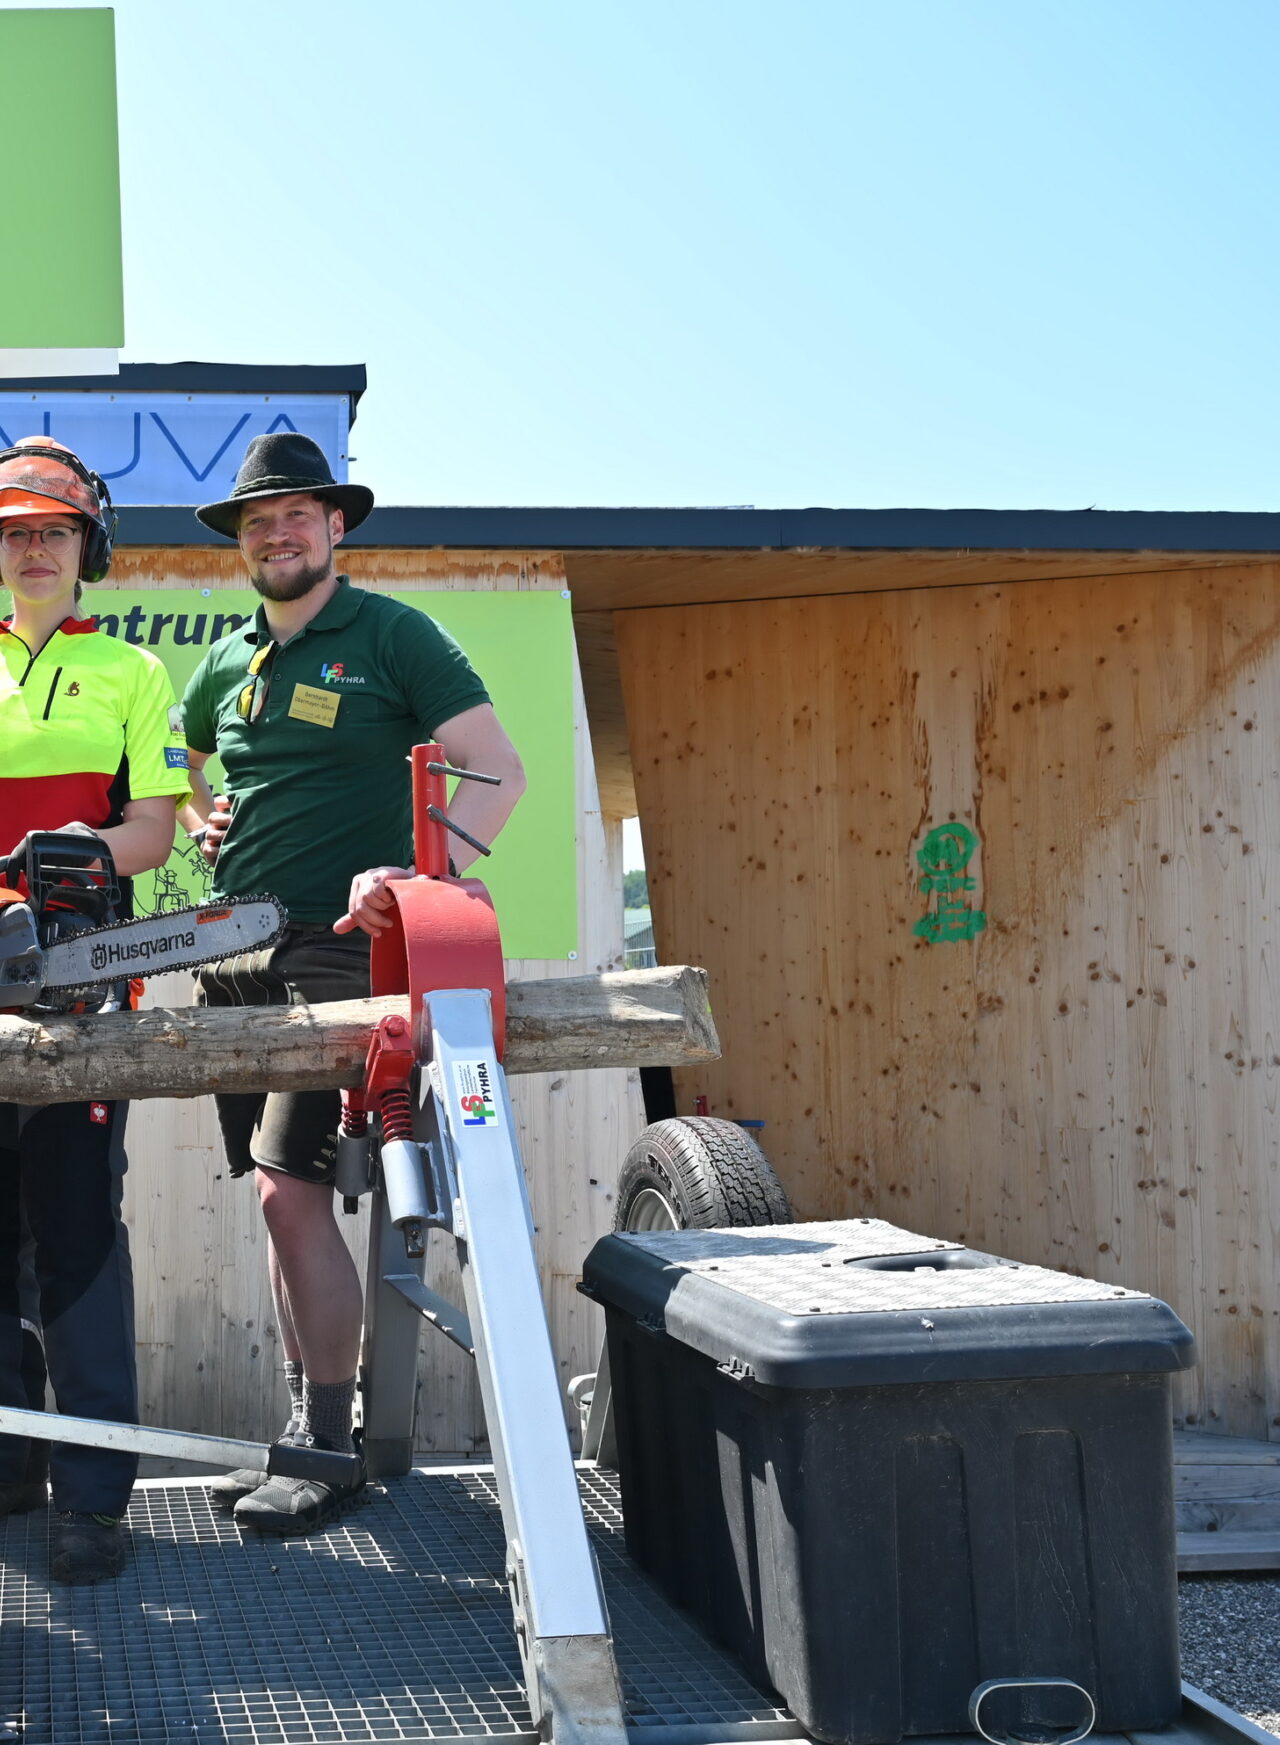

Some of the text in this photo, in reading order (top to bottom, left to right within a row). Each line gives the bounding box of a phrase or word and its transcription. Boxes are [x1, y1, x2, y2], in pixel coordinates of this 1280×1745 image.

[333, 676, 365, 684] PYHRA
[109, 930, 196, 964] Husqvarna
[477, 1062, 493, 1102] PYHRA
